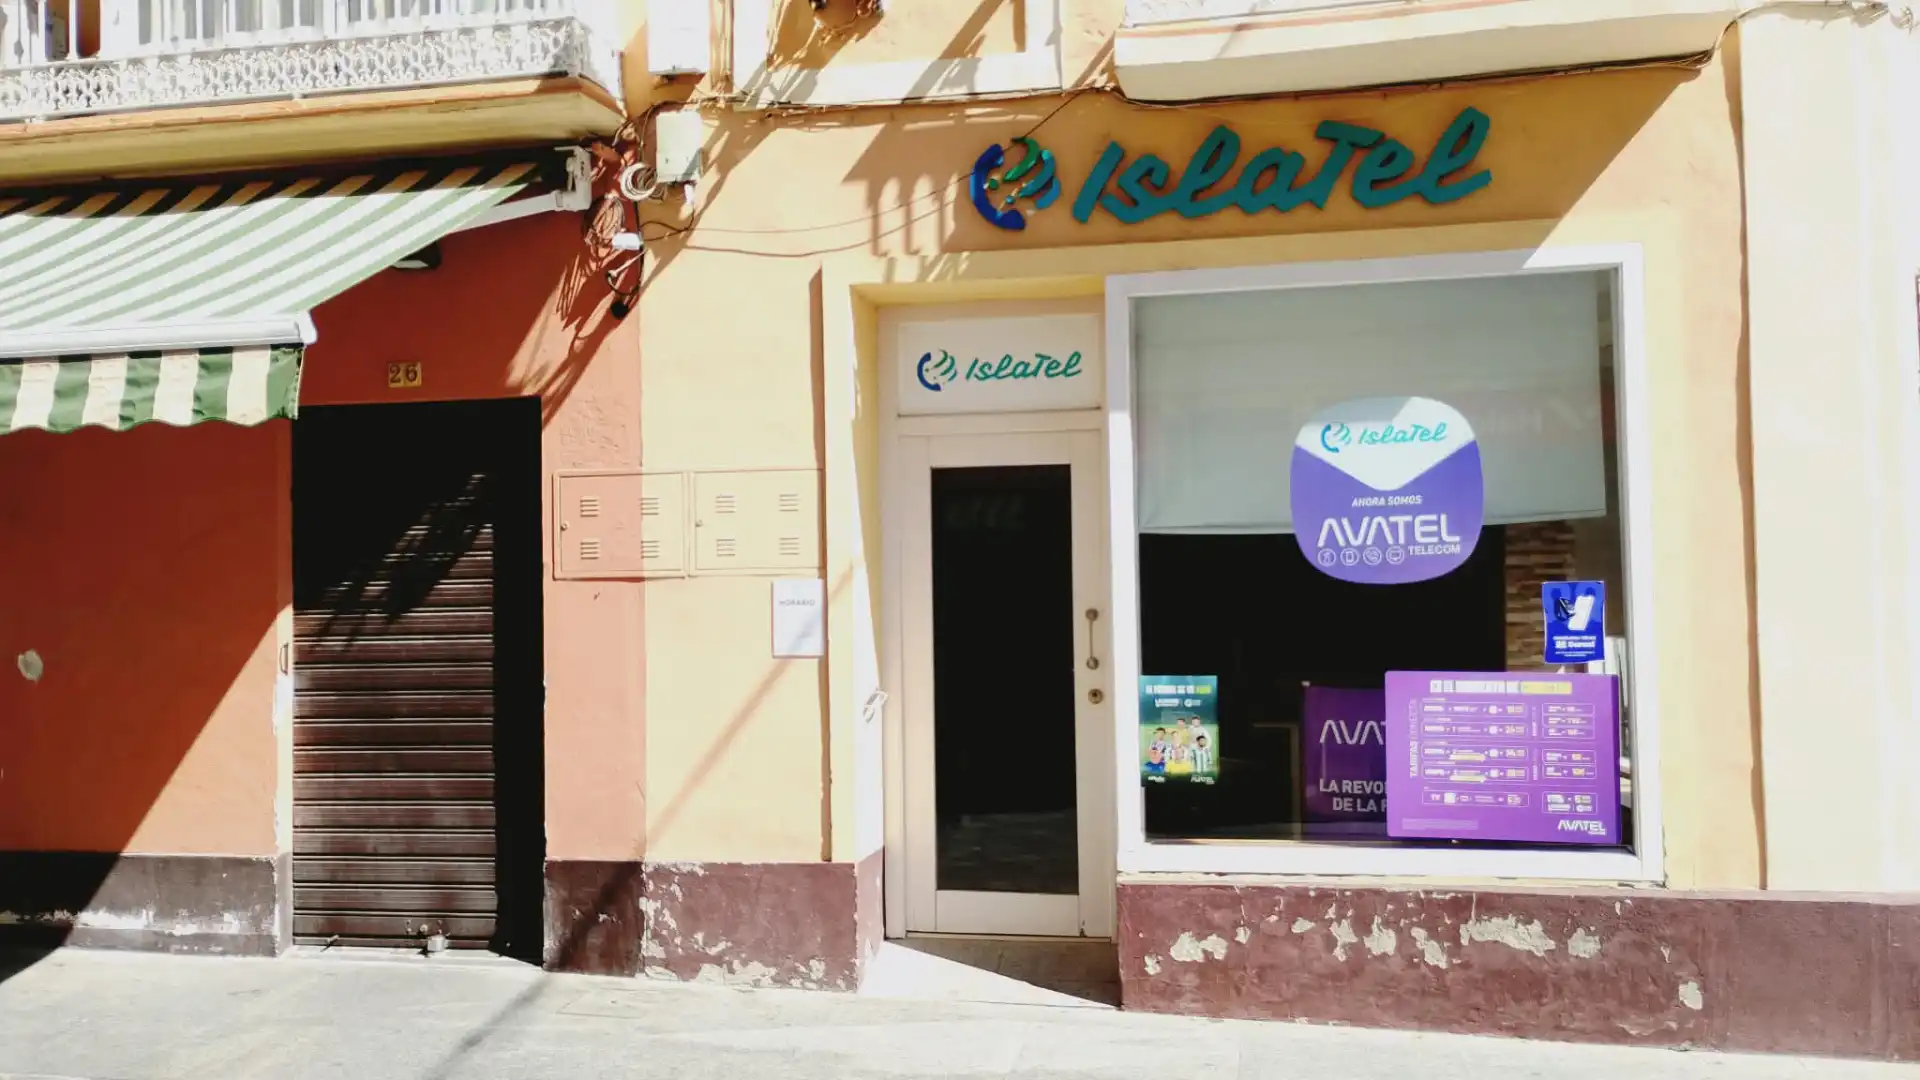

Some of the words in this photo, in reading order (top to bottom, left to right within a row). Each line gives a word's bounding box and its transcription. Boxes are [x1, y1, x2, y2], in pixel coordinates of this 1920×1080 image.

[1072, 106, 1492, 224] IslaTel
[389, 363, 418, 384] 26
[965, 350, 1083, 381] IslaTel
[1358, 422, 1448, 445] IslaTel
[1351, 496, 1386, 508] AHORA
[1387, 494, 1424, 507] SOMOS
[1317, 512, 1461, 548] AVATEL
[1408, 545, 1461, 556] TELECOM
[1319, 778, 1340, 793] LA
[1342, 780, 1387, 794] REVO
[1332, 797, 1353, 811] DE
[1356, 799, 1377, 812] LA
